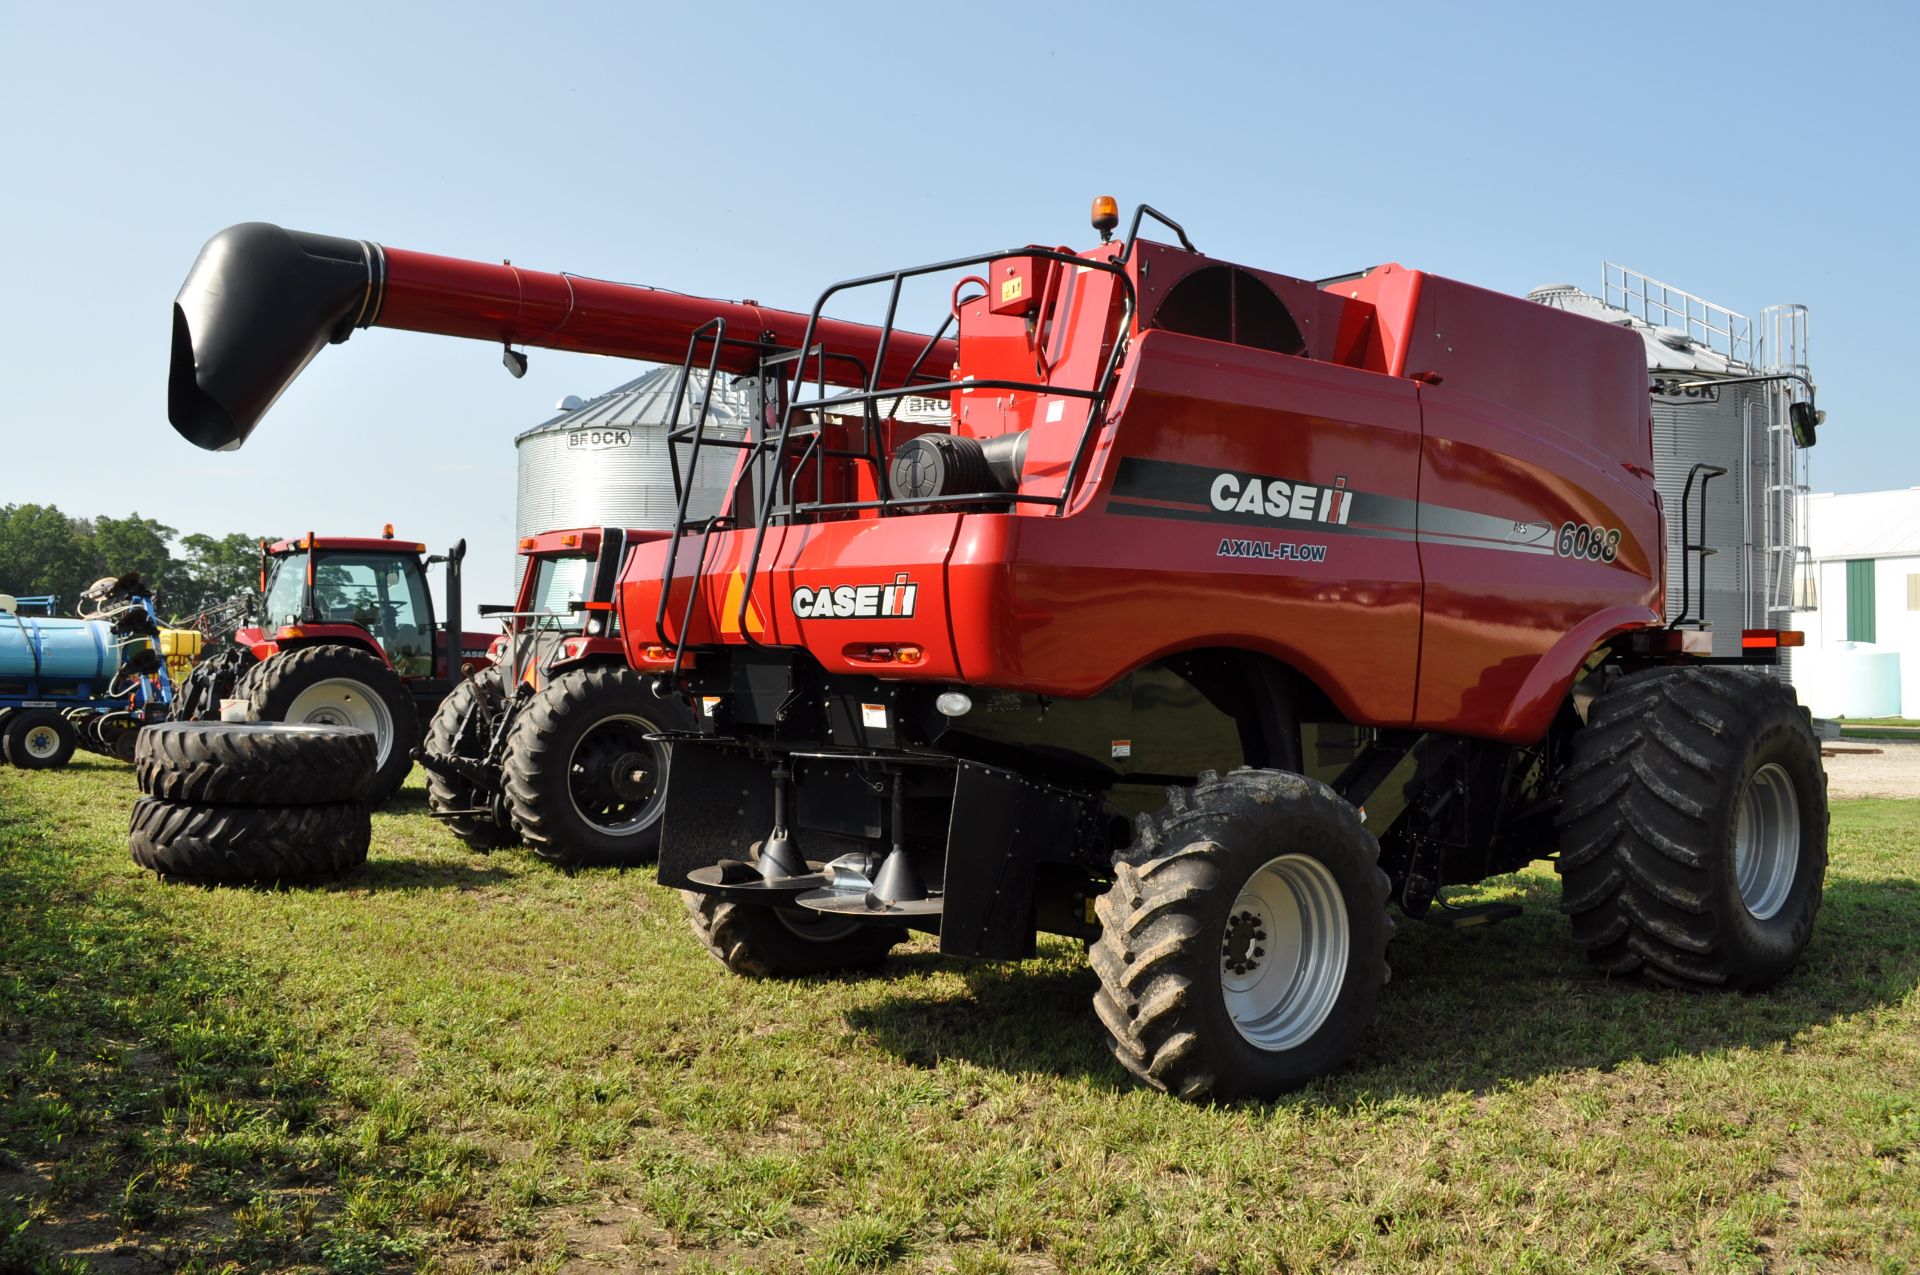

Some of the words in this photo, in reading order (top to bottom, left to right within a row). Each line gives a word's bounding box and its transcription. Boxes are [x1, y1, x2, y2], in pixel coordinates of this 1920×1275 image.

[909, 397, 951, 412] BRO
[1210, 473, 1318, 521] CASE
[1217, 538, 1327, 562] AXIAL-FLOW
[1557, 521, 1621, 563] 6088
[792, 586, 880, 618] CASE
